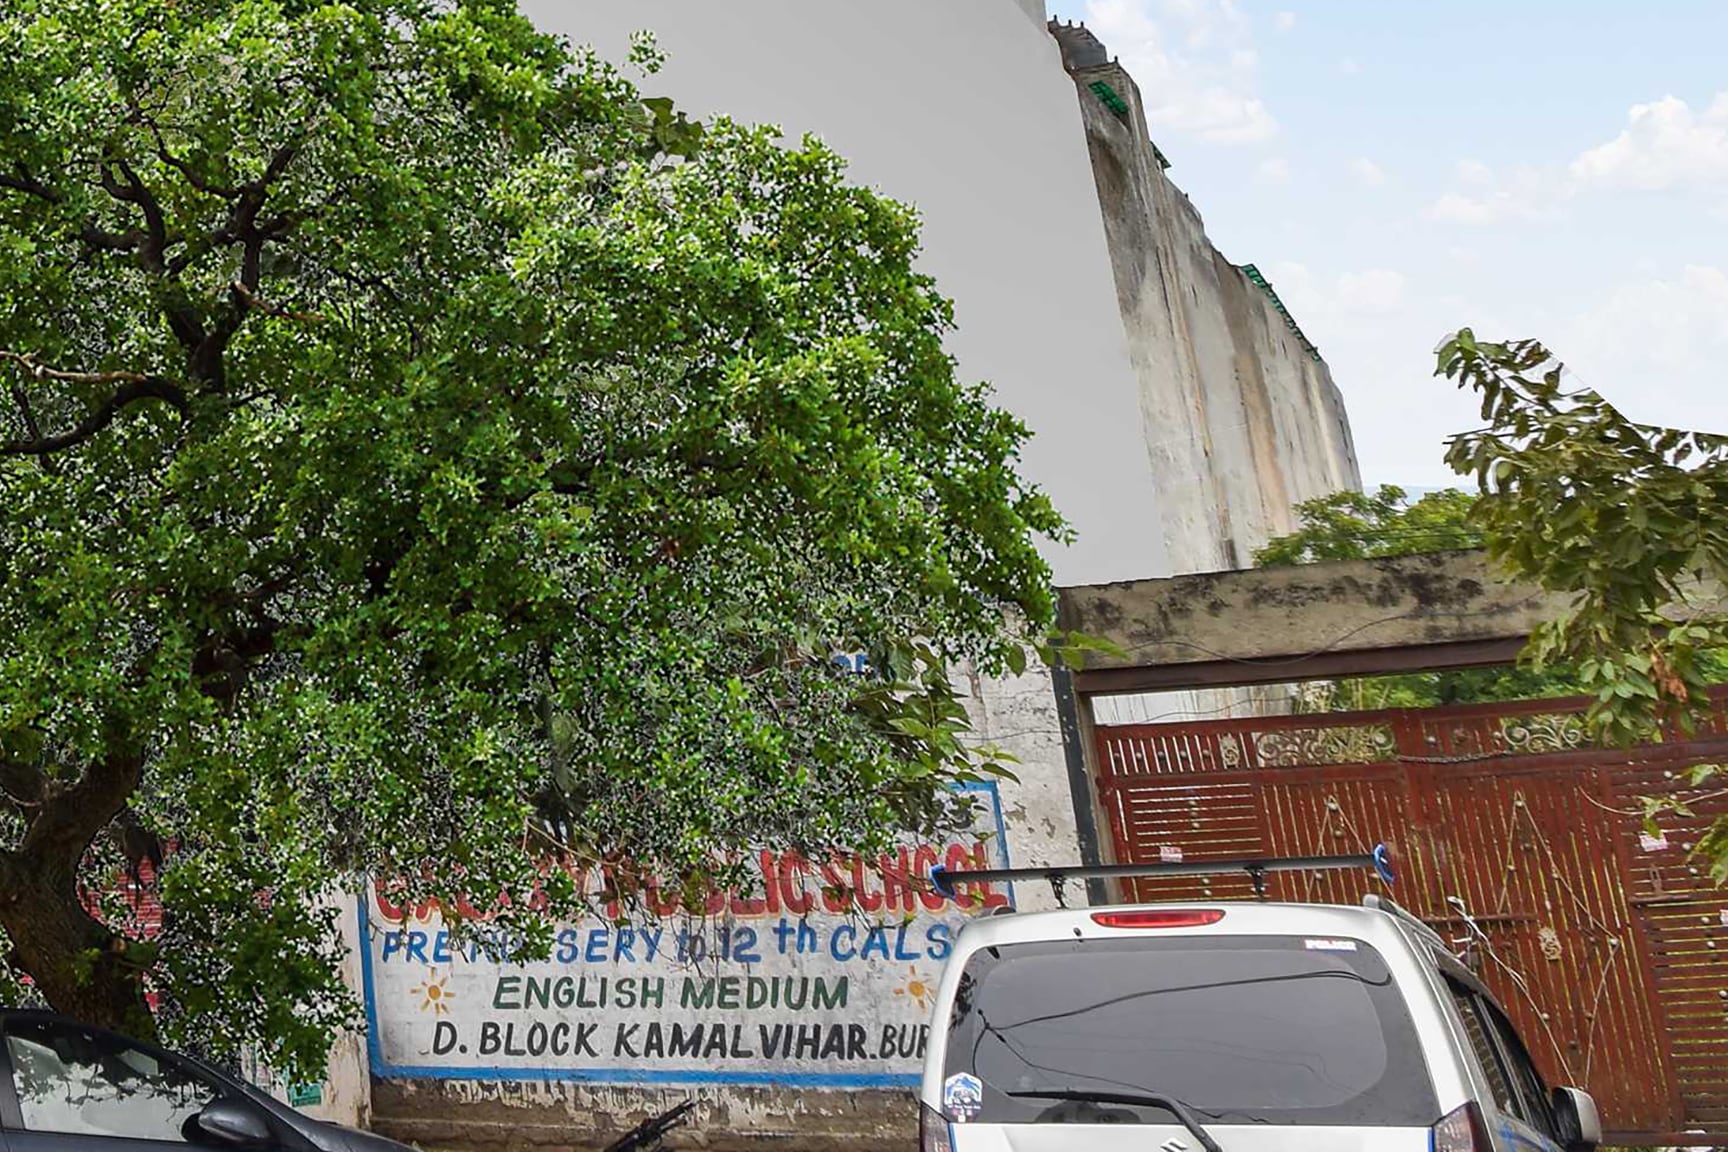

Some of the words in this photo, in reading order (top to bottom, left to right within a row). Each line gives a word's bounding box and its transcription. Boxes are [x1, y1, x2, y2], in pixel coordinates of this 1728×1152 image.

[821, 841, 1009, 913] SCHOOL
[717, 926, 762, 963] 12
[772, 917, 818, 954] th
[492, 975, 665, 1011] ENGLISH
[680, 974, 849, 1011] MEDIUM
[479, 1020, 600, 1057] BLOCK
[612, 1022, 754, 1060] KAMAL
